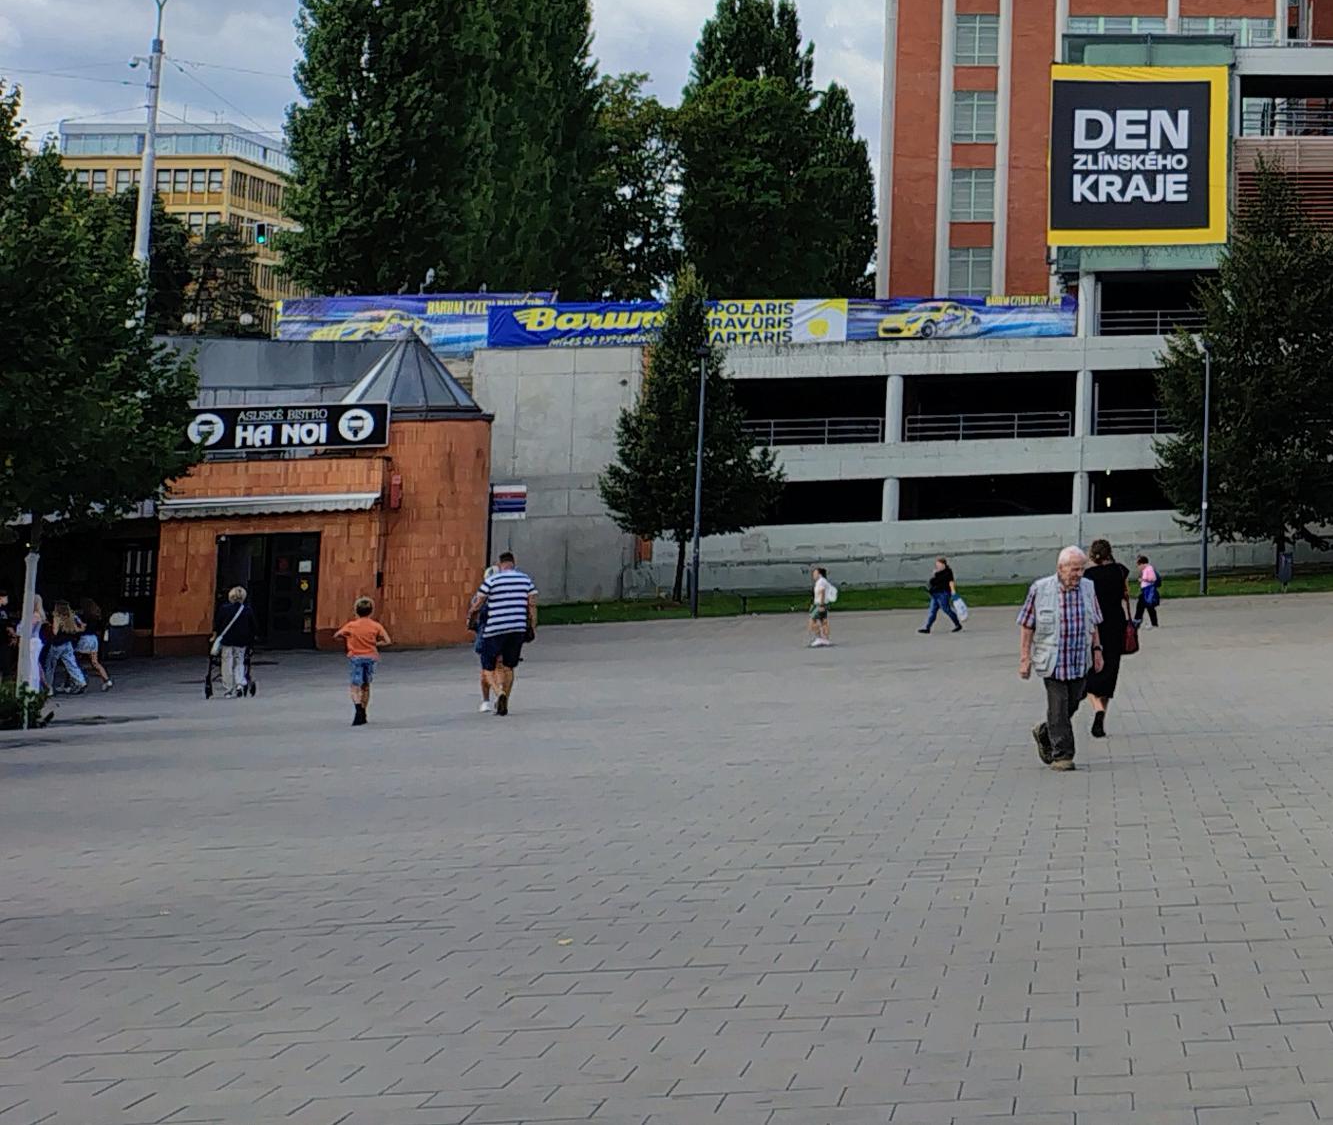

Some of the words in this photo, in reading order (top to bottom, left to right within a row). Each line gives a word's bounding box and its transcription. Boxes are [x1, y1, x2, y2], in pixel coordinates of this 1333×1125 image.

[1073, 109, 1188, 151] DEN
[1073, 151, 1188, 171] ZLÍNSKÉHO
[1073, 175, 1188, 203] KRAJE
[513, 306, 667, 331] Barum
[713, 302, 794, 315] POLARIS
[287, 409, 328, 420] BISTRO
[235, 424, 272, 448] HA
[281, 423, 327, 445] NOI
